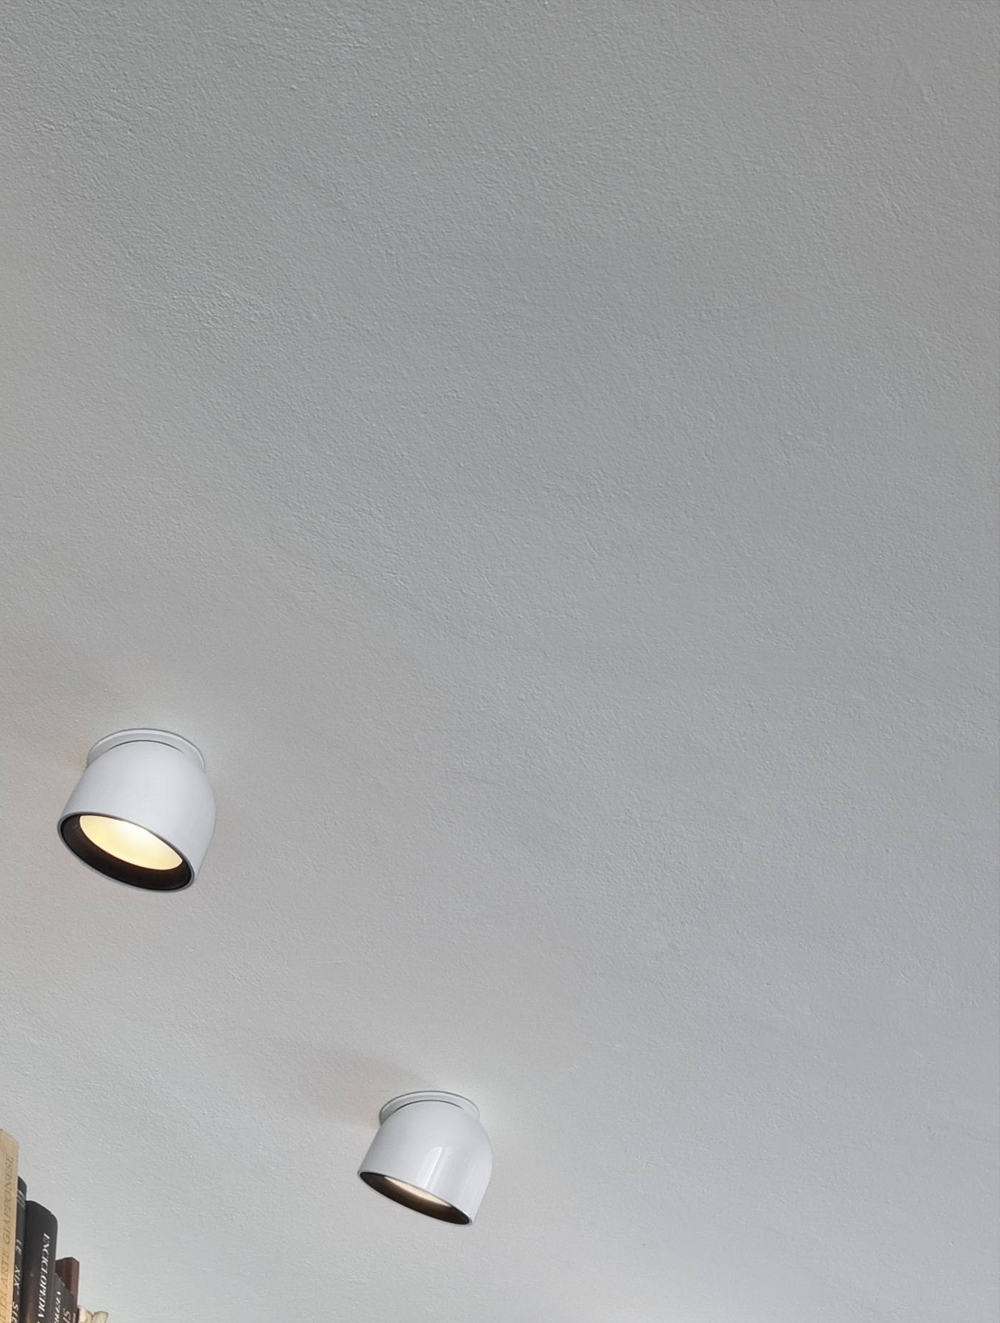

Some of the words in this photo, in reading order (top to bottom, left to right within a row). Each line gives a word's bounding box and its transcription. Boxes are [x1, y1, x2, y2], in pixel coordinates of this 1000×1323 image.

[2, 1154, 14, 1244] GIAPPONESE
[0, 1247, 10, 1286] ARTE
[15, 1238, 23, 1255] LE
[37, 1232, 51, 1319] ENCICLOPEDIA
